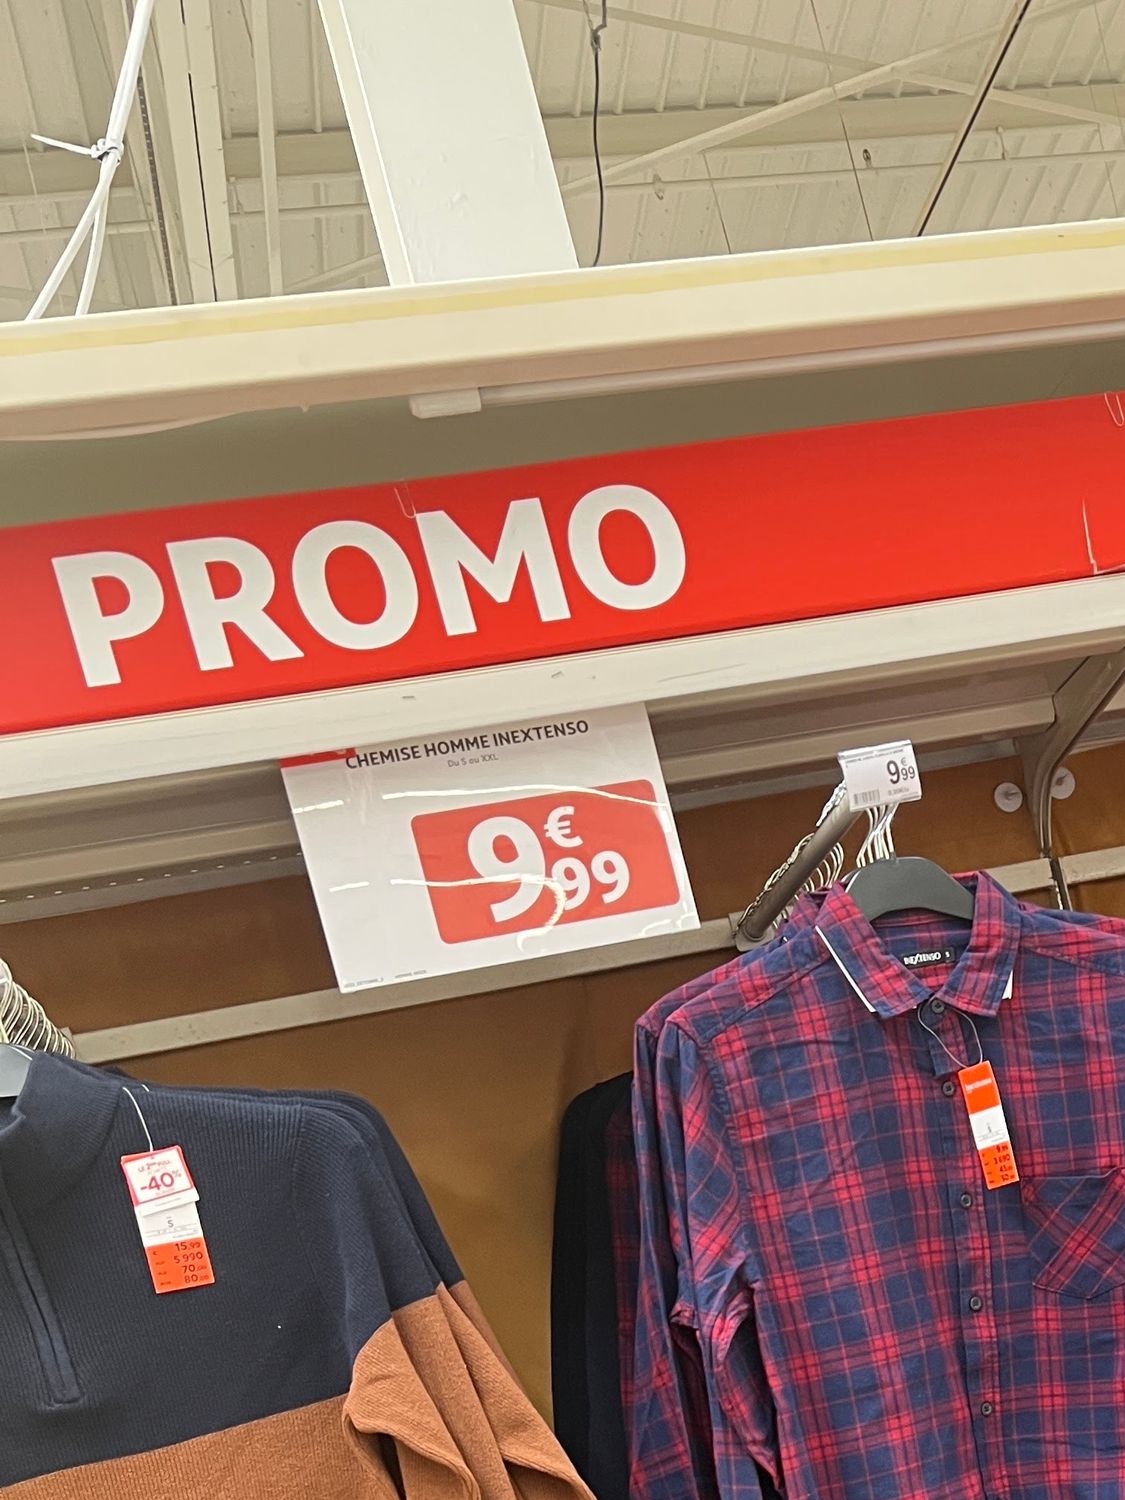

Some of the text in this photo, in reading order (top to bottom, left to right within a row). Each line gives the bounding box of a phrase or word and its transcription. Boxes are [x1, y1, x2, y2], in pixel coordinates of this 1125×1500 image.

[51, 484, 687, 688] PROMO
[345, 719, 590, 769] CHEMISE HOMME INEXTENSO
[447, 759, 460, 767] Du
[461, 758, 467, 766] S
[481, 754, 500, 763] XXL
